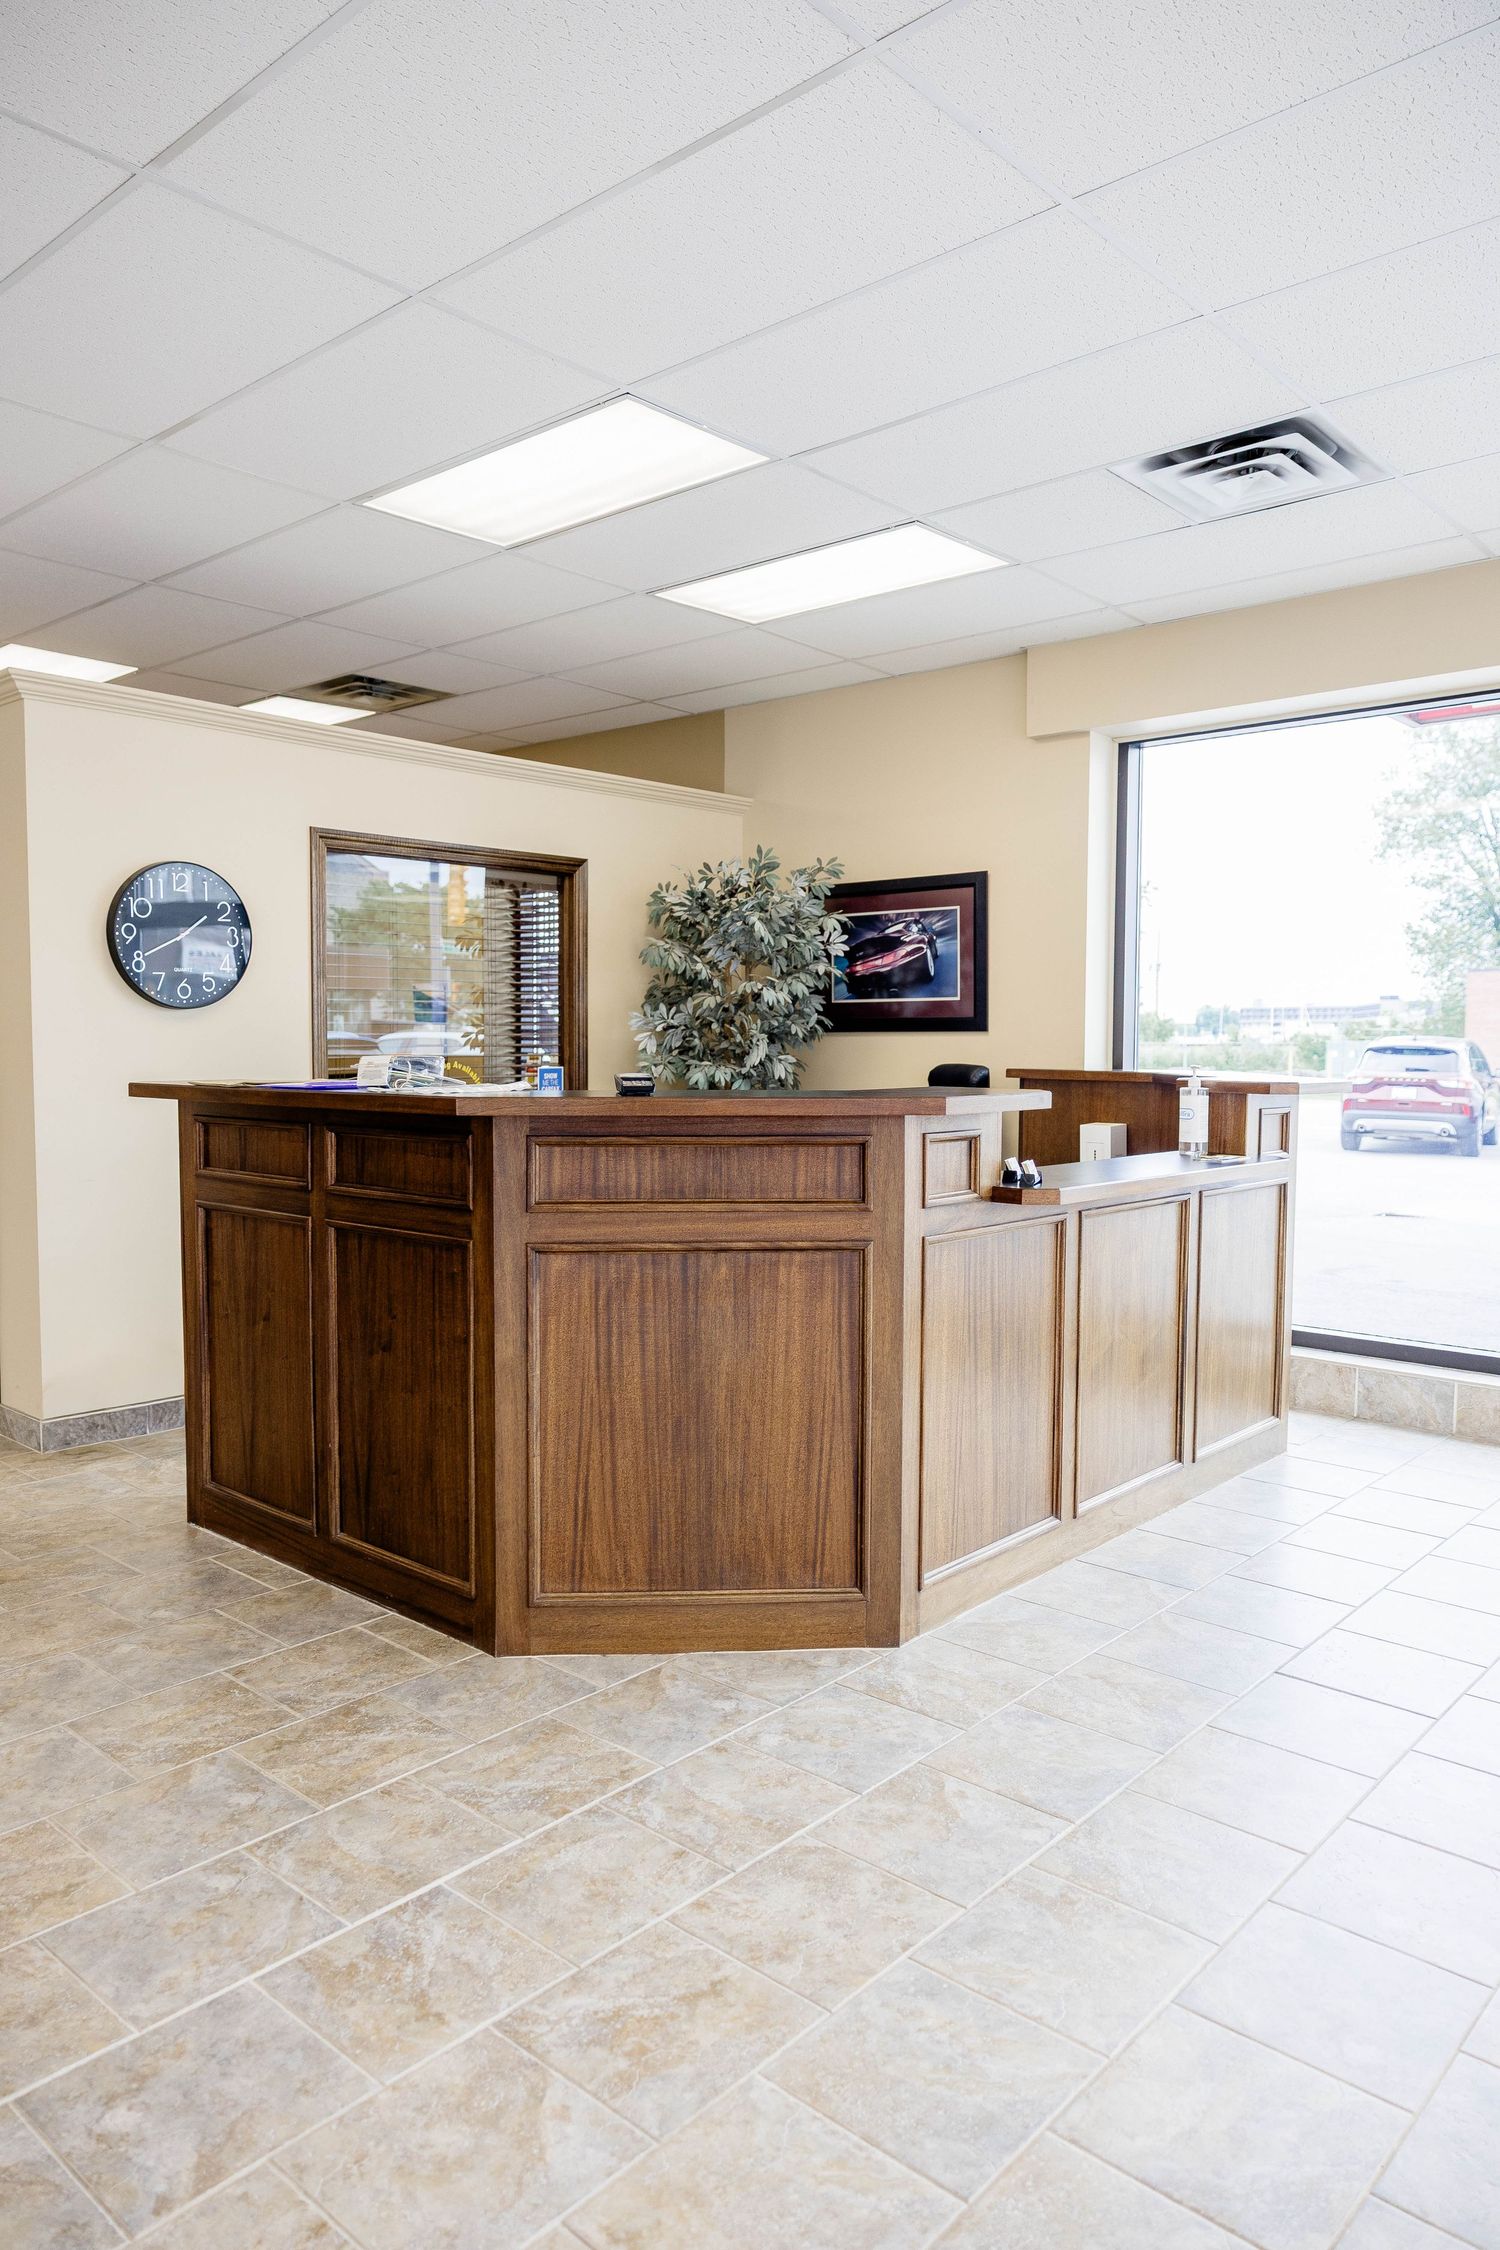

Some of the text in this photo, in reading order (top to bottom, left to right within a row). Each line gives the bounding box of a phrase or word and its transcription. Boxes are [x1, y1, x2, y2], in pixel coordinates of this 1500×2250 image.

[148, 877, 164, 899] 11
[171, 872, 189, 892] 12
[202, 881, 208, 901] 1
[128, 896, 152, 918] 10
[217, 901, 231, 922] 2
[121, 922, 137, 945] 9
[226, 926, 239, 948] 3
[131, 950, 146, 973] 8
[219, 953, 232, 973] 4
[152, 972, 166, 991] 7
[176, 978, 192, 999] 6
[202, 971, 216, 992] 5
